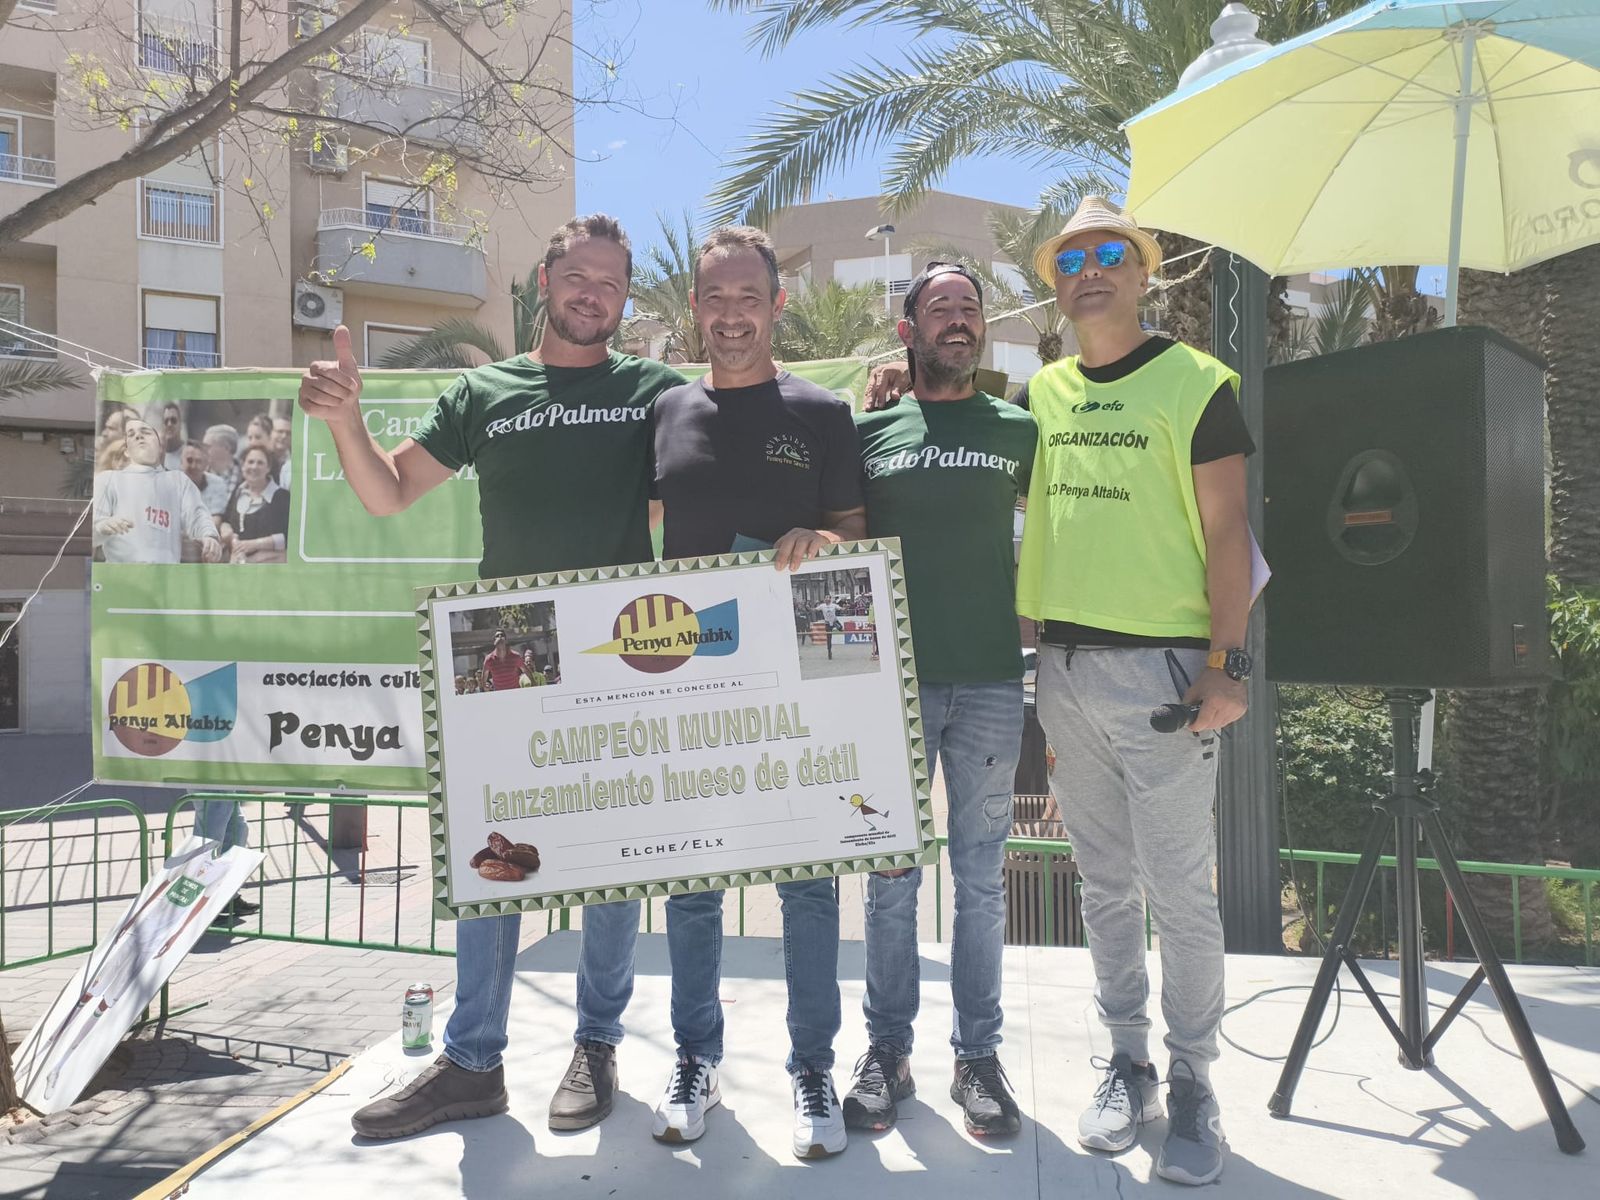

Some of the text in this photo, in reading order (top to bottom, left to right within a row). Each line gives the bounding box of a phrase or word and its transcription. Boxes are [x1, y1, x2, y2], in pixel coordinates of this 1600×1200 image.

[1101, 400, 1125, 411] efa
[1048, 430, 1149, 450] ORGANIZACIÓN
[1060, 483, 1089, 499] Penya
[1091, 485, 1131, 502] Altabix
[145, 505, 170, 528] 1753
[623, 628, 734, 653] Penya Altabix
[263, 671, 373, 688] asociación
[575, 696, 602, 704] ESTA
[607, 689, 655, 700] MENCIÓN
[677, 682, 727, 693] CONCEDE
[165, 714, 233, 731] Altabix
[265, 711, 405, 761] Penya
[528, 702, 812, 768] CAMPEÓN MUNDIAL
[483, 743, 860, 823] lanzamiento hueso de dátil
[621, 837, 724, 858] ELCHE/ELX
